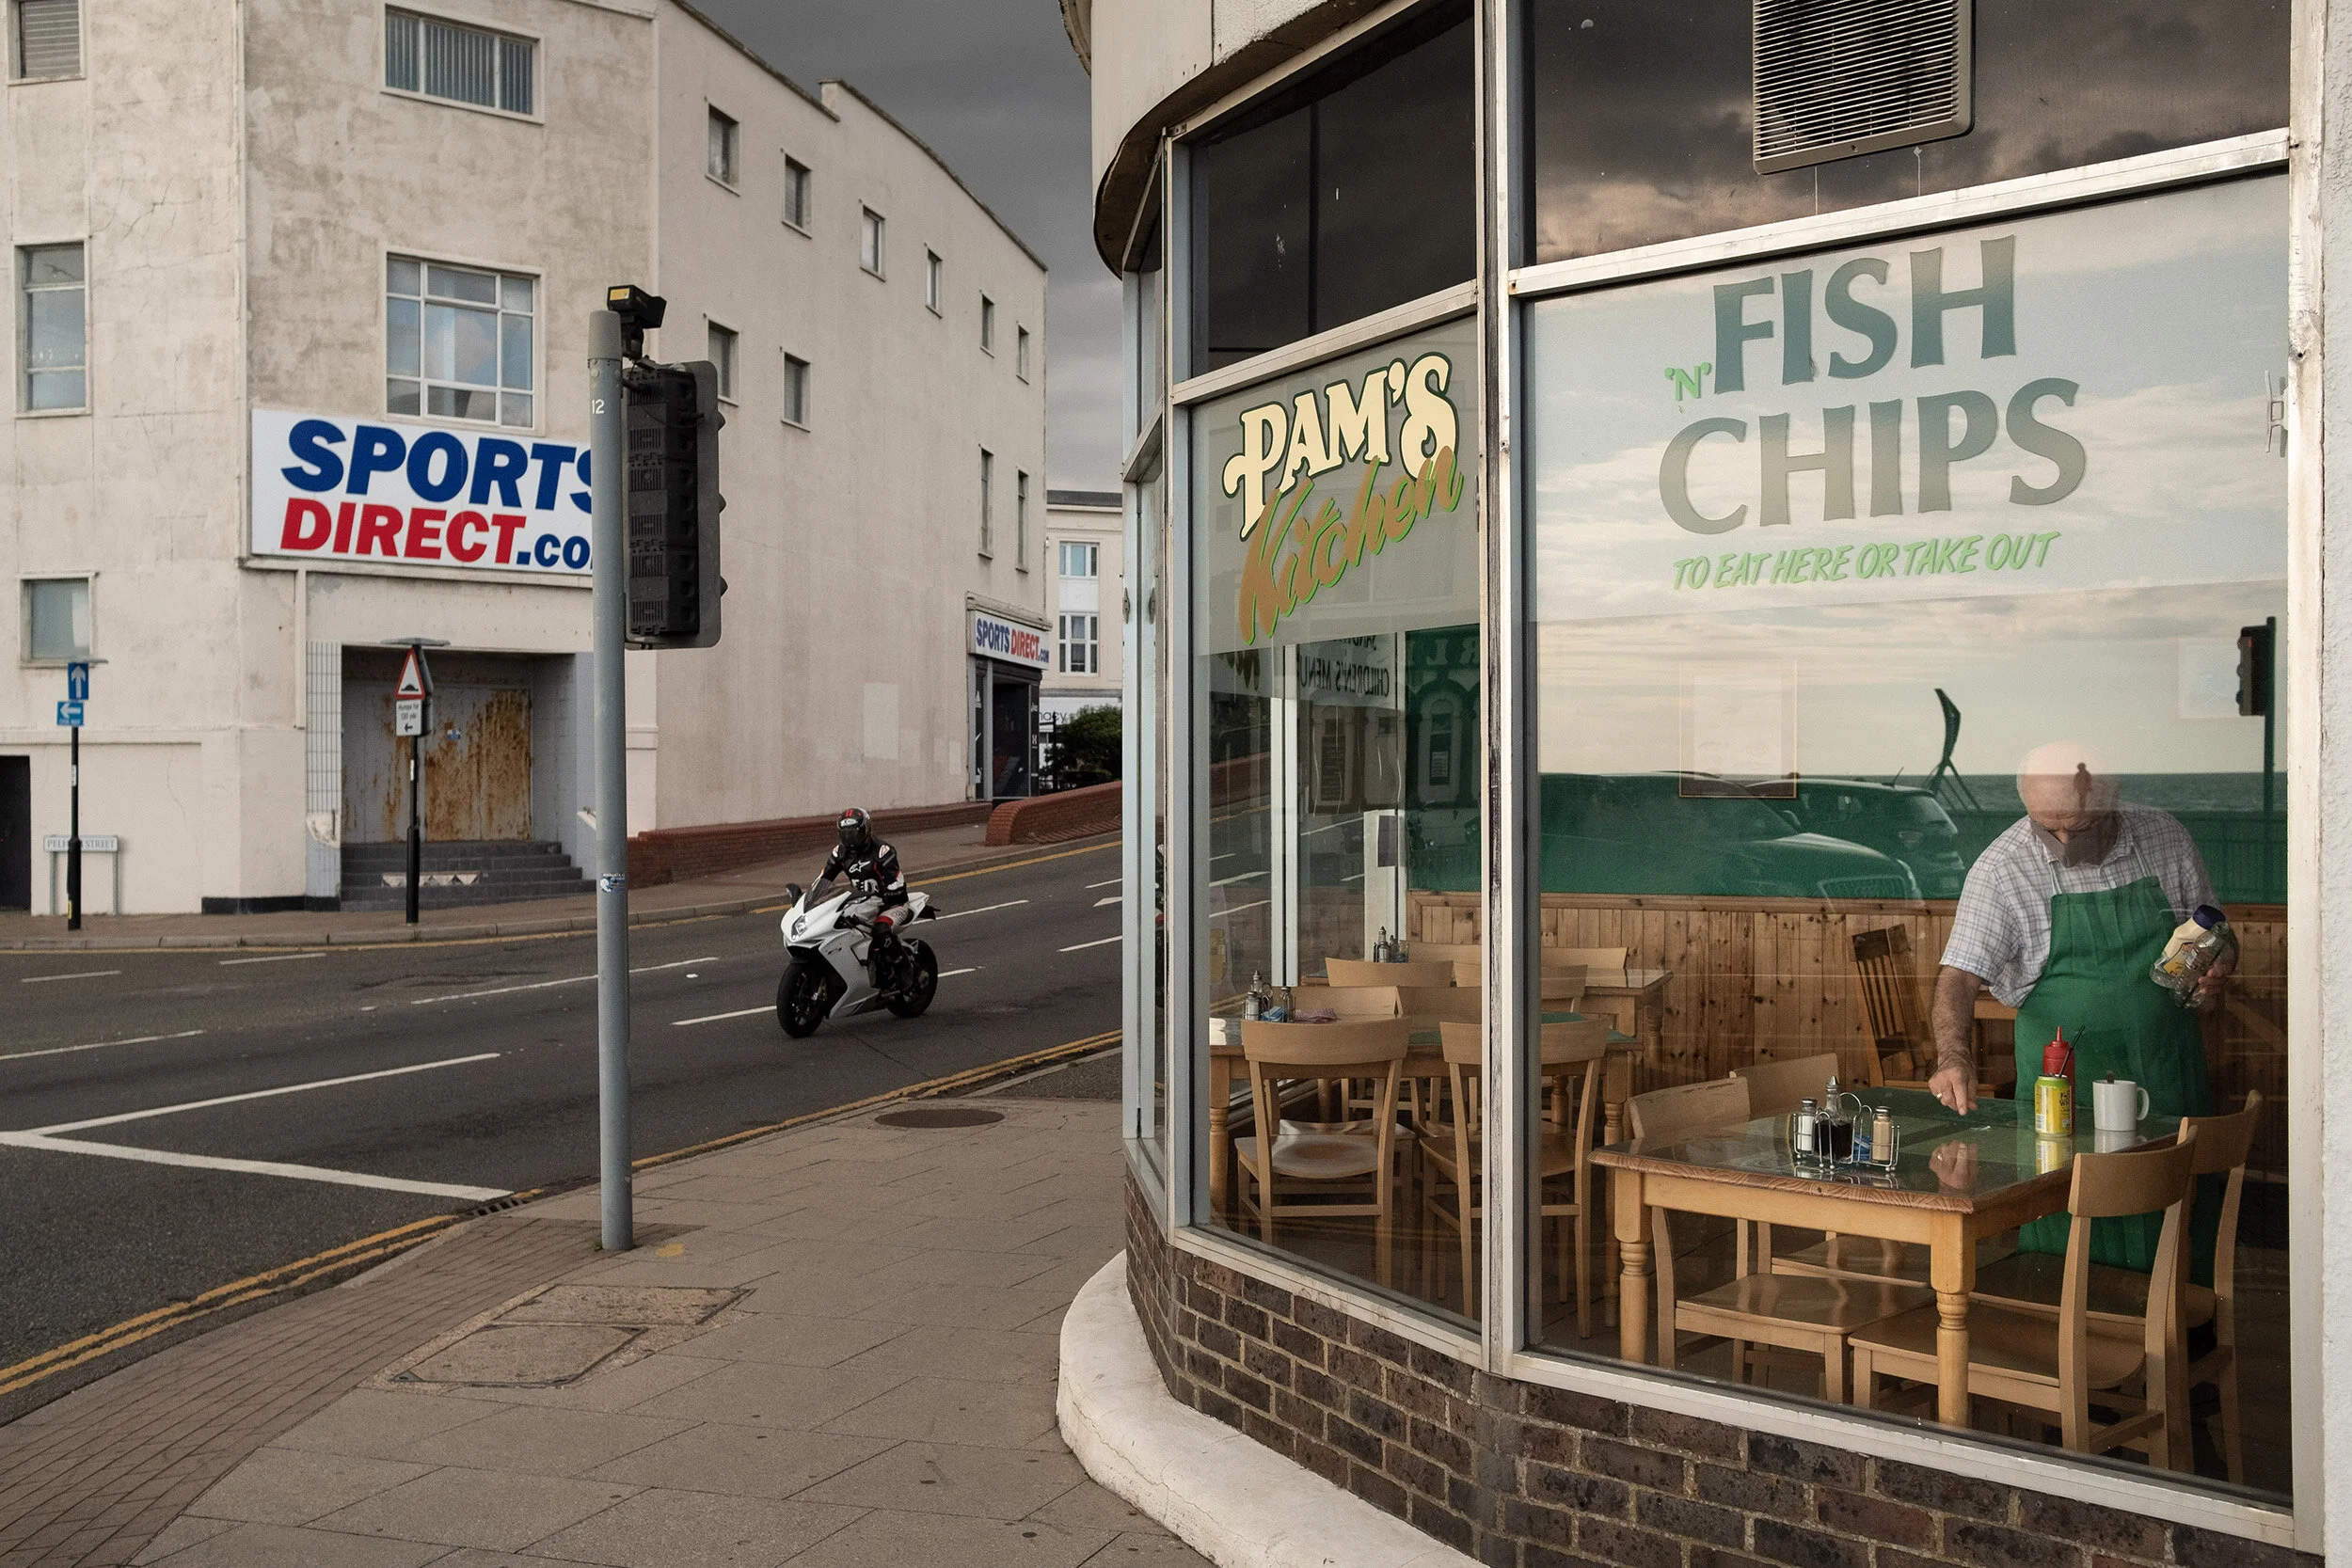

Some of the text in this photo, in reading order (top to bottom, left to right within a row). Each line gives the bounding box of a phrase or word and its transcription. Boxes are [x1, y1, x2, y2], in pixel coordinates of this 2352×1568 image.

[1713, 234, 2017, 394] FISH
[592, 399, 605, 414] 12
[1223, 351, 1459, 542] PAM'S
[1659, 377, 2087, 535] CHIPS
[279, 497, 593, 570] DIRECT.CO
[1238, 445, 1464, 645] Kitchen
[1671, 531, 2061, 591] TO EAT HERE OR TAKE OUT
[976, 617, 1010, 654] SPORTS
[85, 839, 115, 849] STREET
